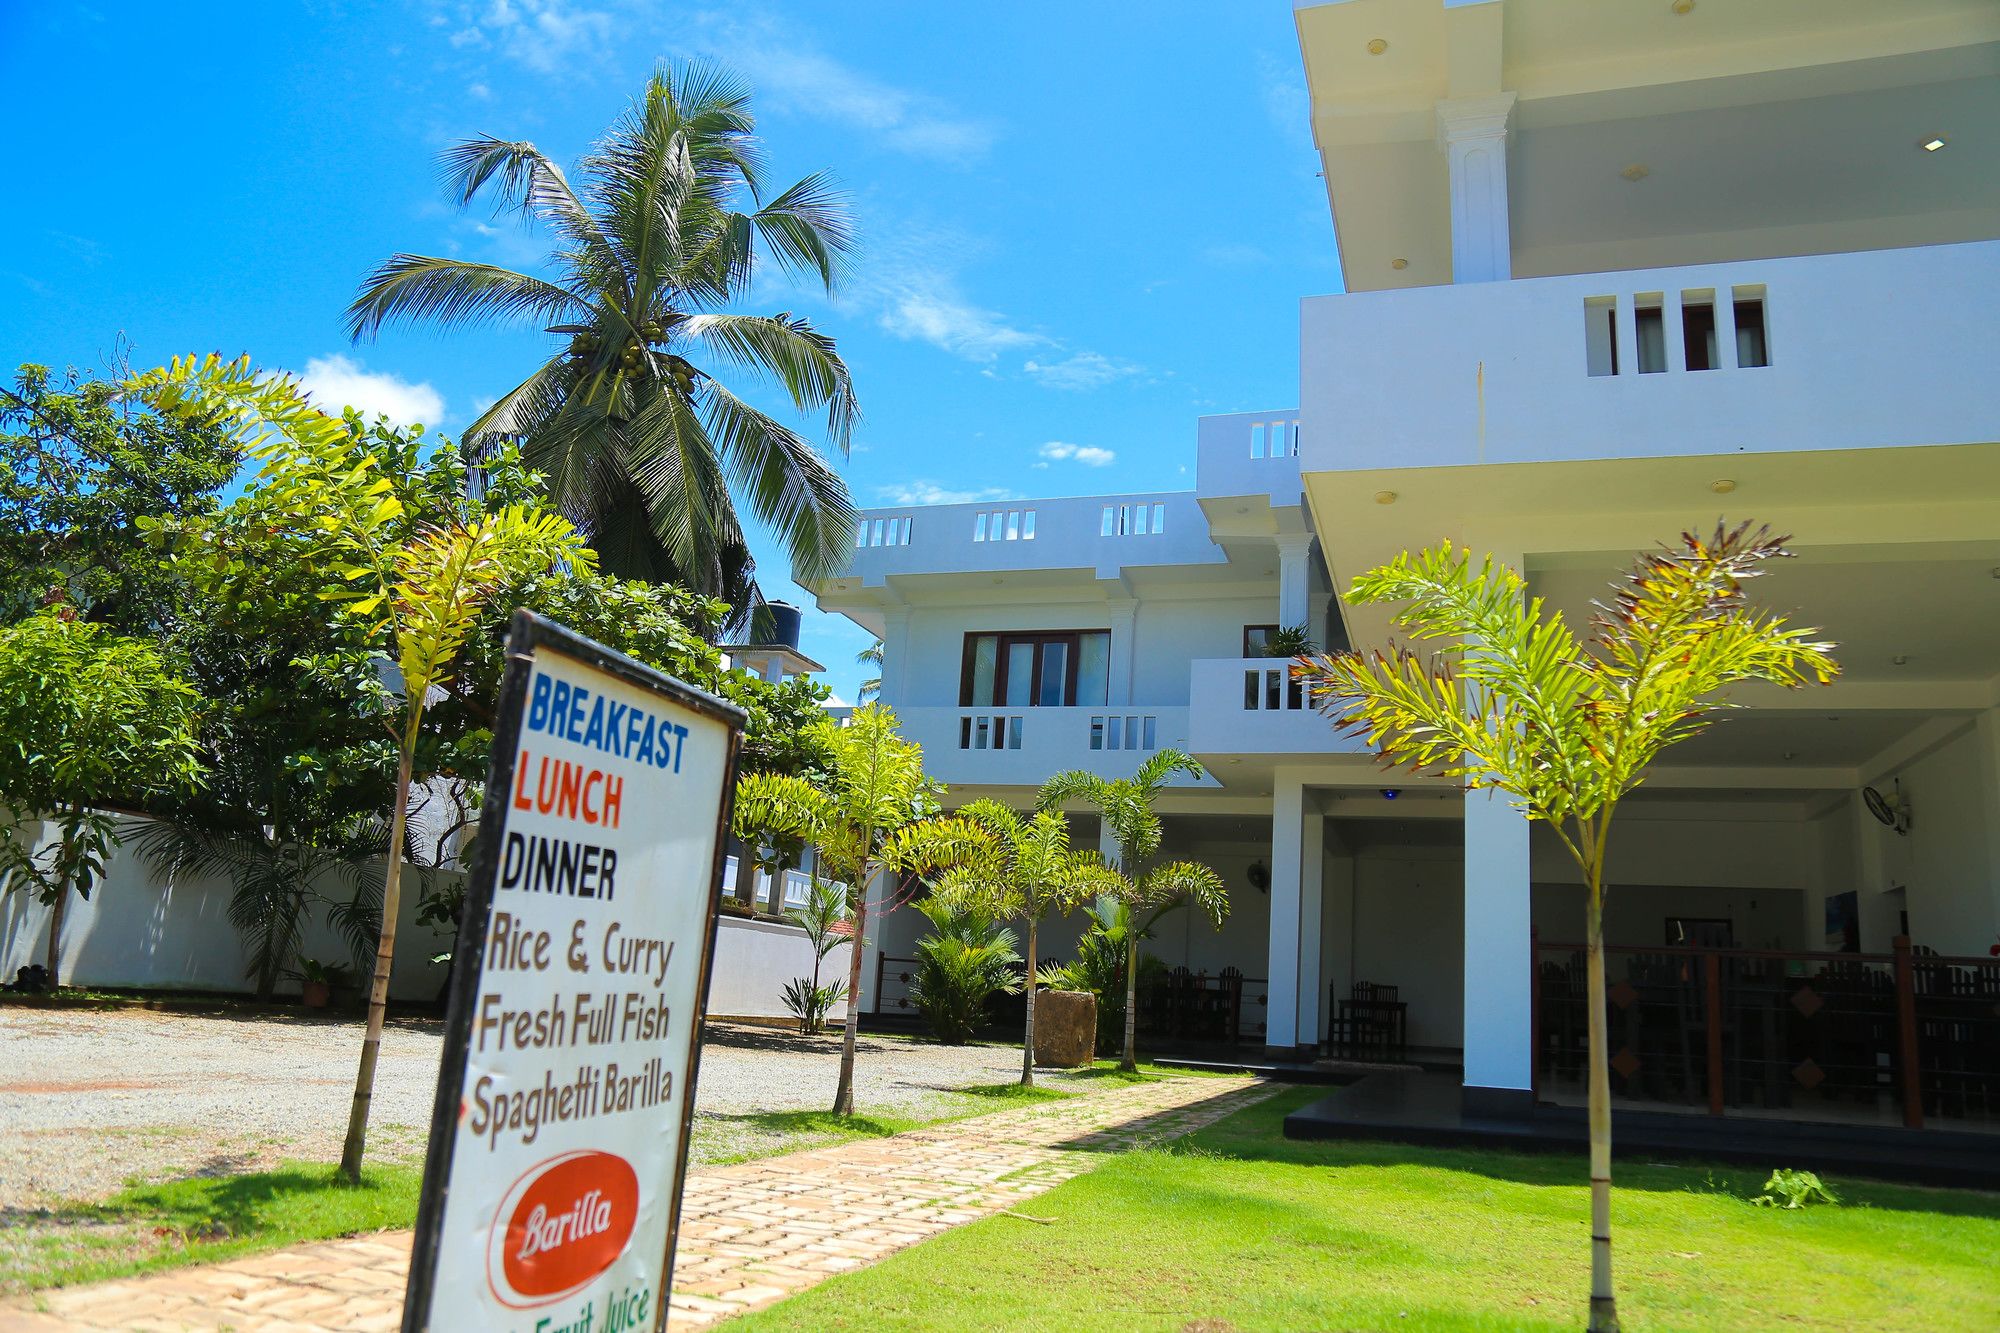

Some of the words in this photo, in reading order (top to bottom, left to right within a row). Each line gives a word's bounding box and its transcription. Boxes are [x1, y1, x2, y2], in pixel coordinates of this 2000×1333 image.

[528, 672, 688, 773] BREAKFAST
[513, 750, 623, 829] LUNCH
[500, 831, 618, 900] DINNER
[488, 912, 551, 971] Rice
[567, 919, 590, 973] &
[603, 921, 675, 988] Curry
[478, 993, 566, 1053] Fresh
[570, 993, 617, 1046] Full
[620, 992, 671, 1042] Fish
[471, 1066, 600, 1150] Spaghetti
[602, 1058, 673, 1115] Barilla
[516, 1189, 612, 1261] Barilla
